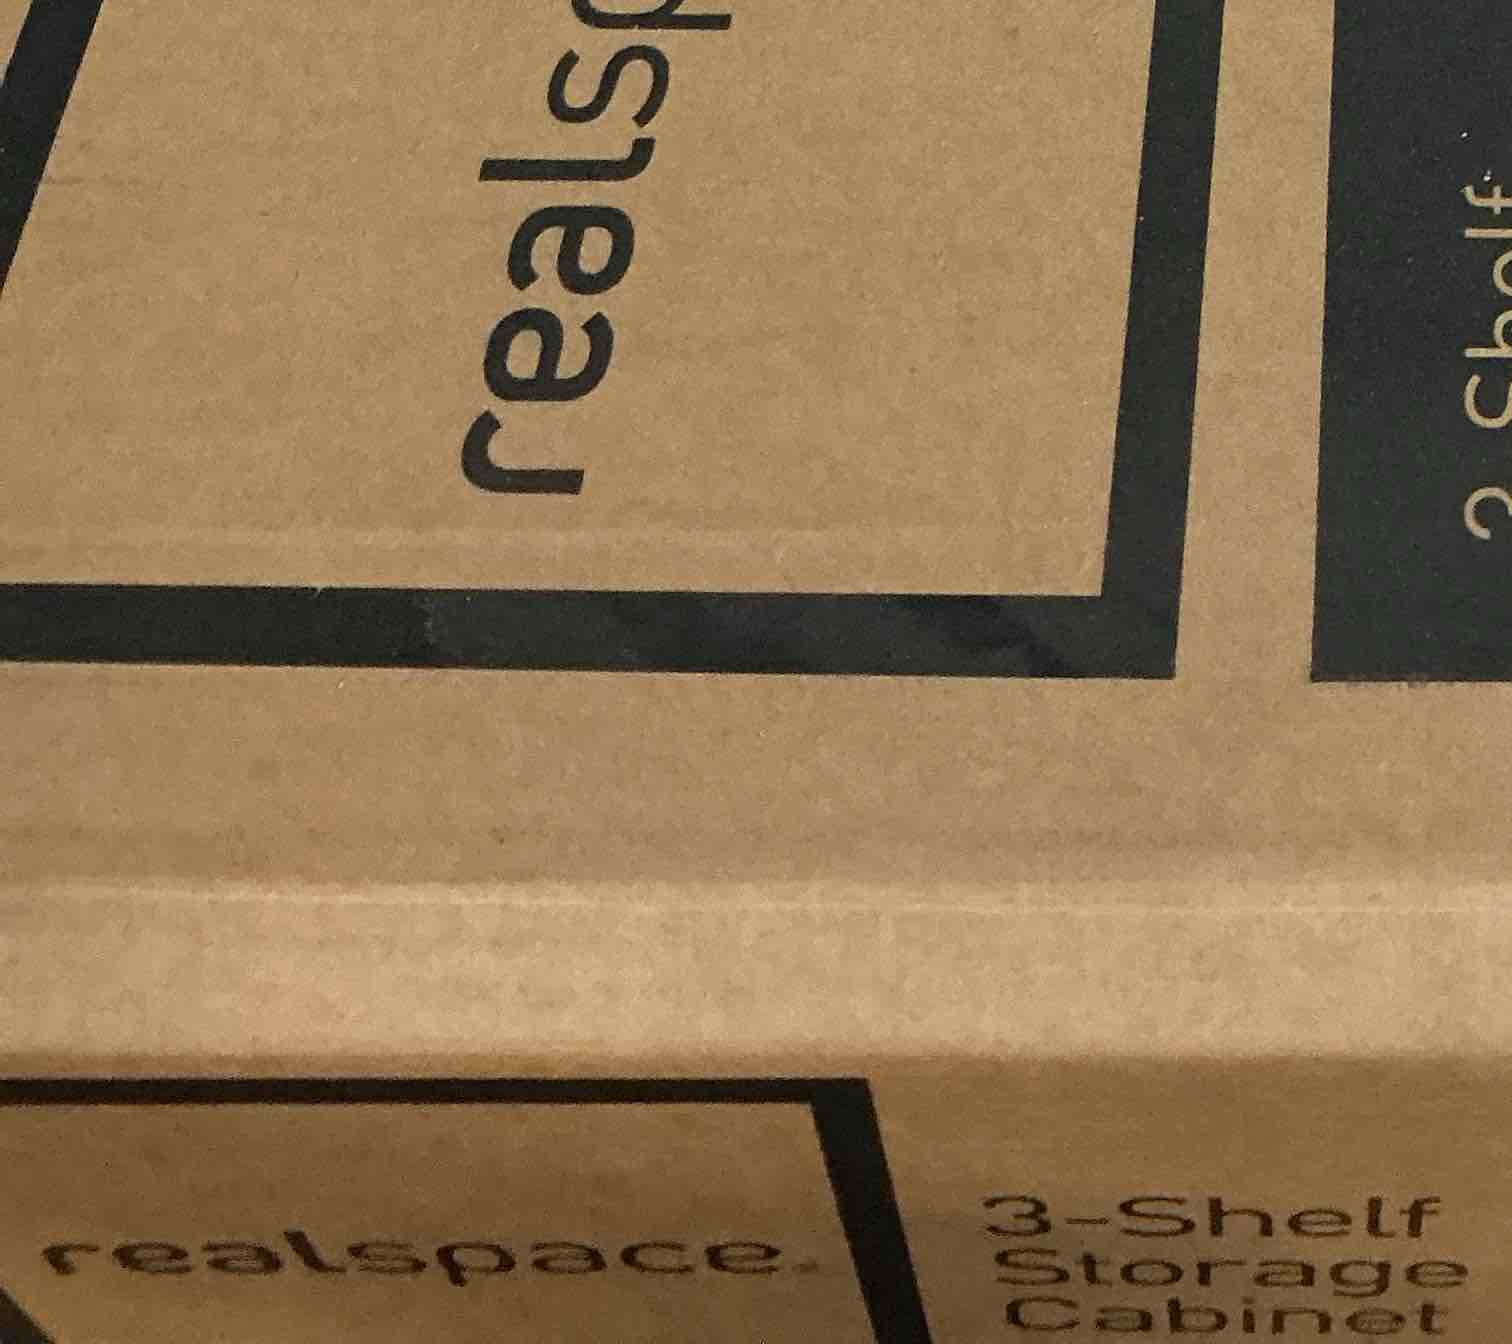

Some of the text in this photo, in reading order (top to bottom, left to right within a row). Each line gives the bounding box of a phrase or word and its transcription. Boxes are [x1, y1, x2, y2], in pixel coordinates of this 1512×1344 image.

[983, 1195, 1441, 1240] 3-Shelf
[994, 1248, 1469, 1297] Storage
[1004, 1296, 1447, 1335] Cabinet
